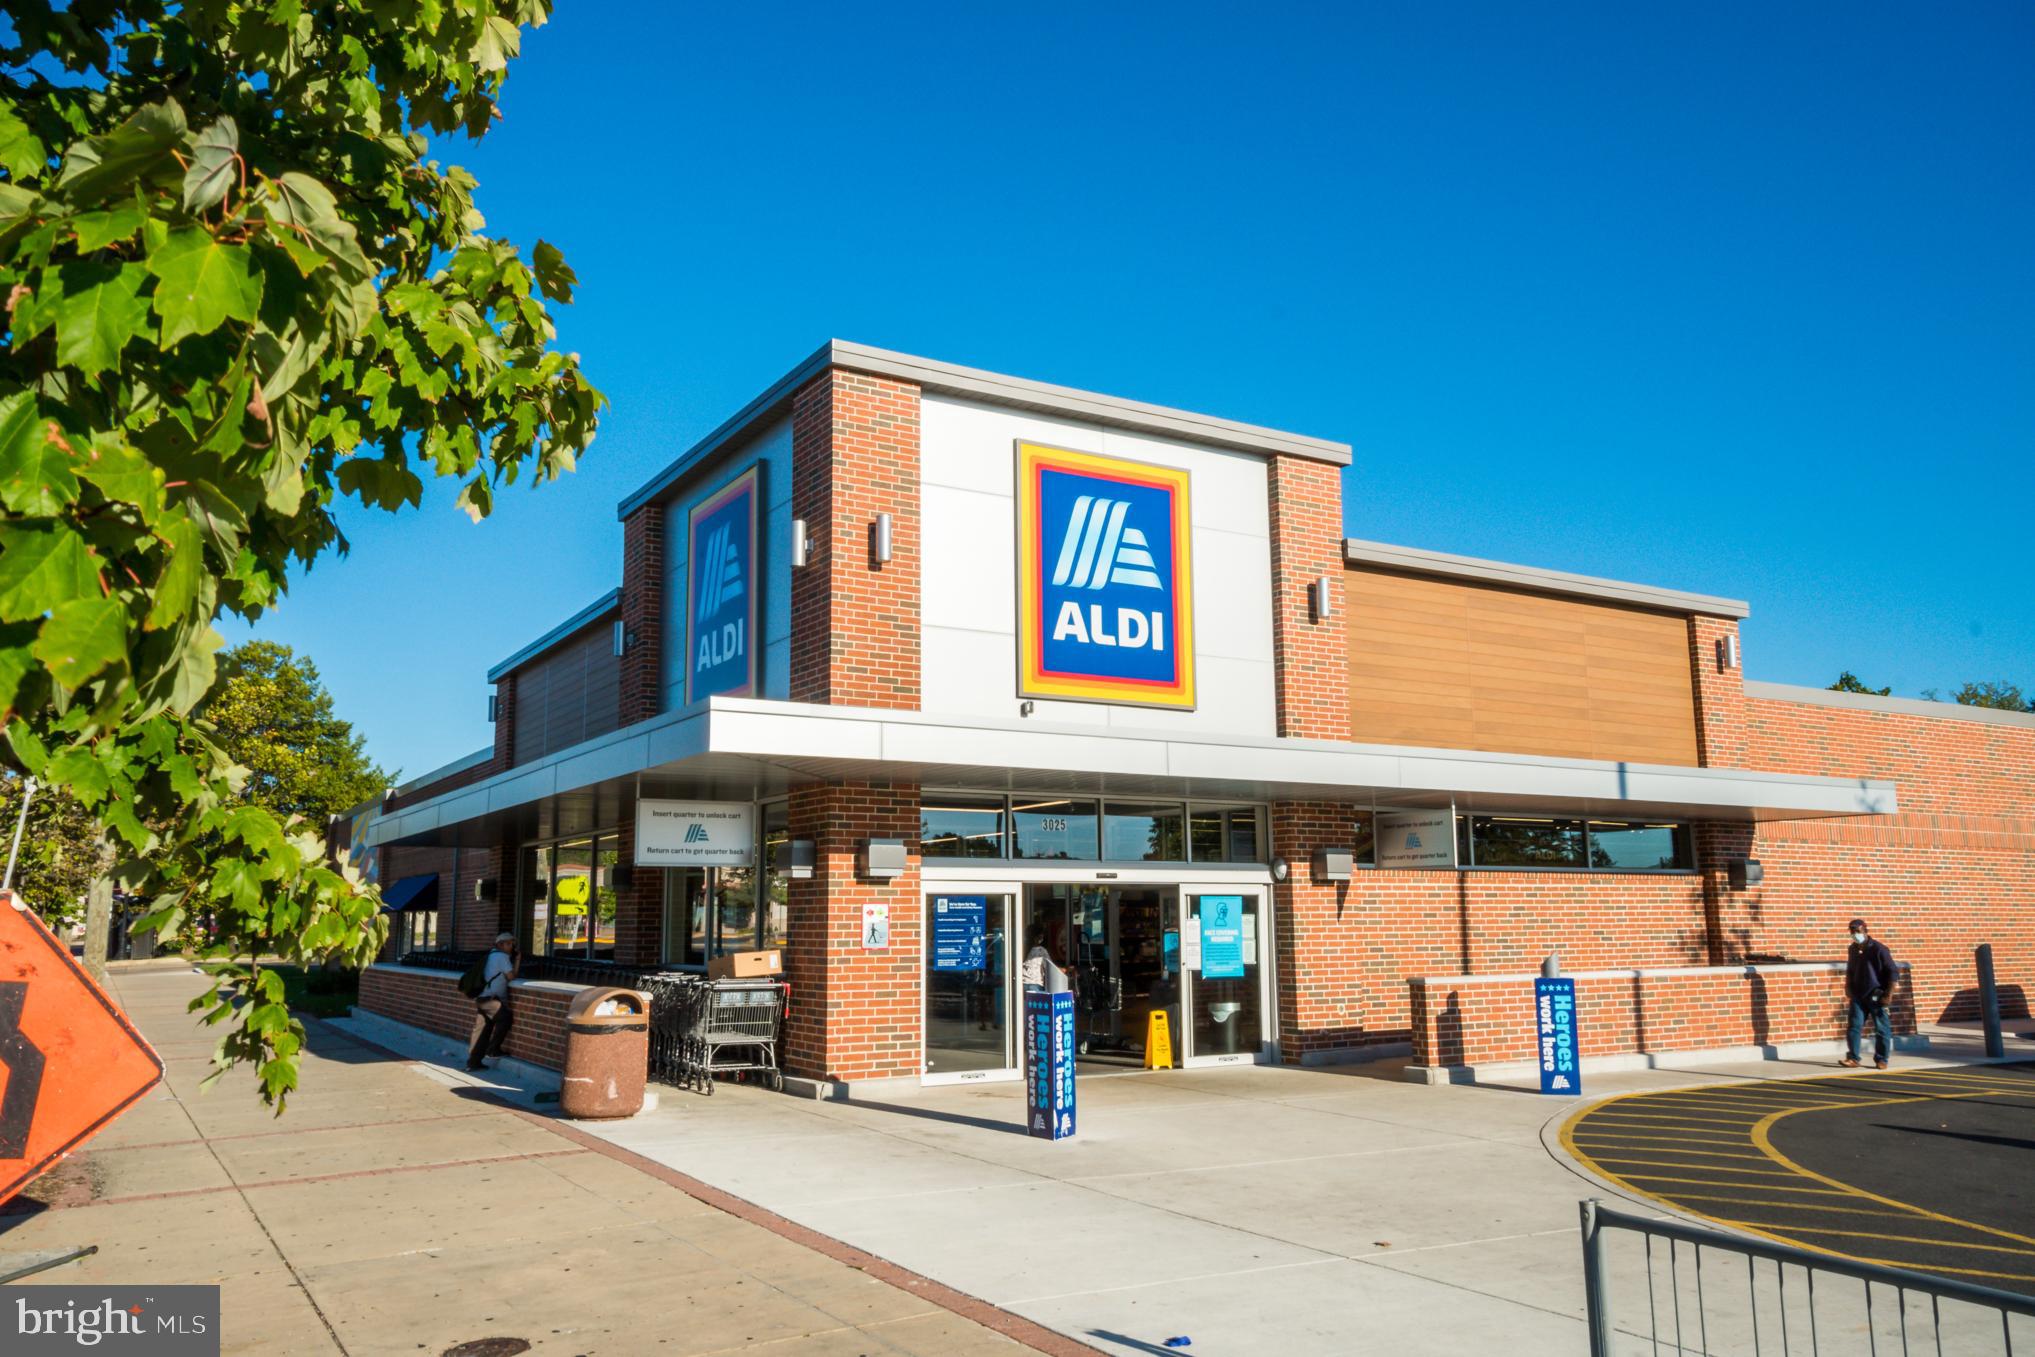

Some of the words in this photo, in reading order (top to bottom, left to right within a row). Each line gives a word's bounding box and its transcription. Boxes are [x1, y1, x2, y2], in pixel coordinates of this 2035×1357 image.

[697, 617, 744, 673] ALDI
[1053, 601, 1164, 651] ALDI
[706, 811, 727, 819] unlock
[1042, 818, 1067, 831] 3025
[1028, 1014, 1037, 1061] work
[1055, 1014, 1064, 1063] work
[1540, 995, 1556, 1035] work
[1554, 995, 1573, 1072] Heroes
[1037, 1014, 1049, 1109] Heroes
[1064, 1013, 1072, 1108] Heroes
[1542, 1037, 1557, 1072] here
[1029, 1066, 1037, 1107] here
[1056, 1067, 1064, 1110] here
